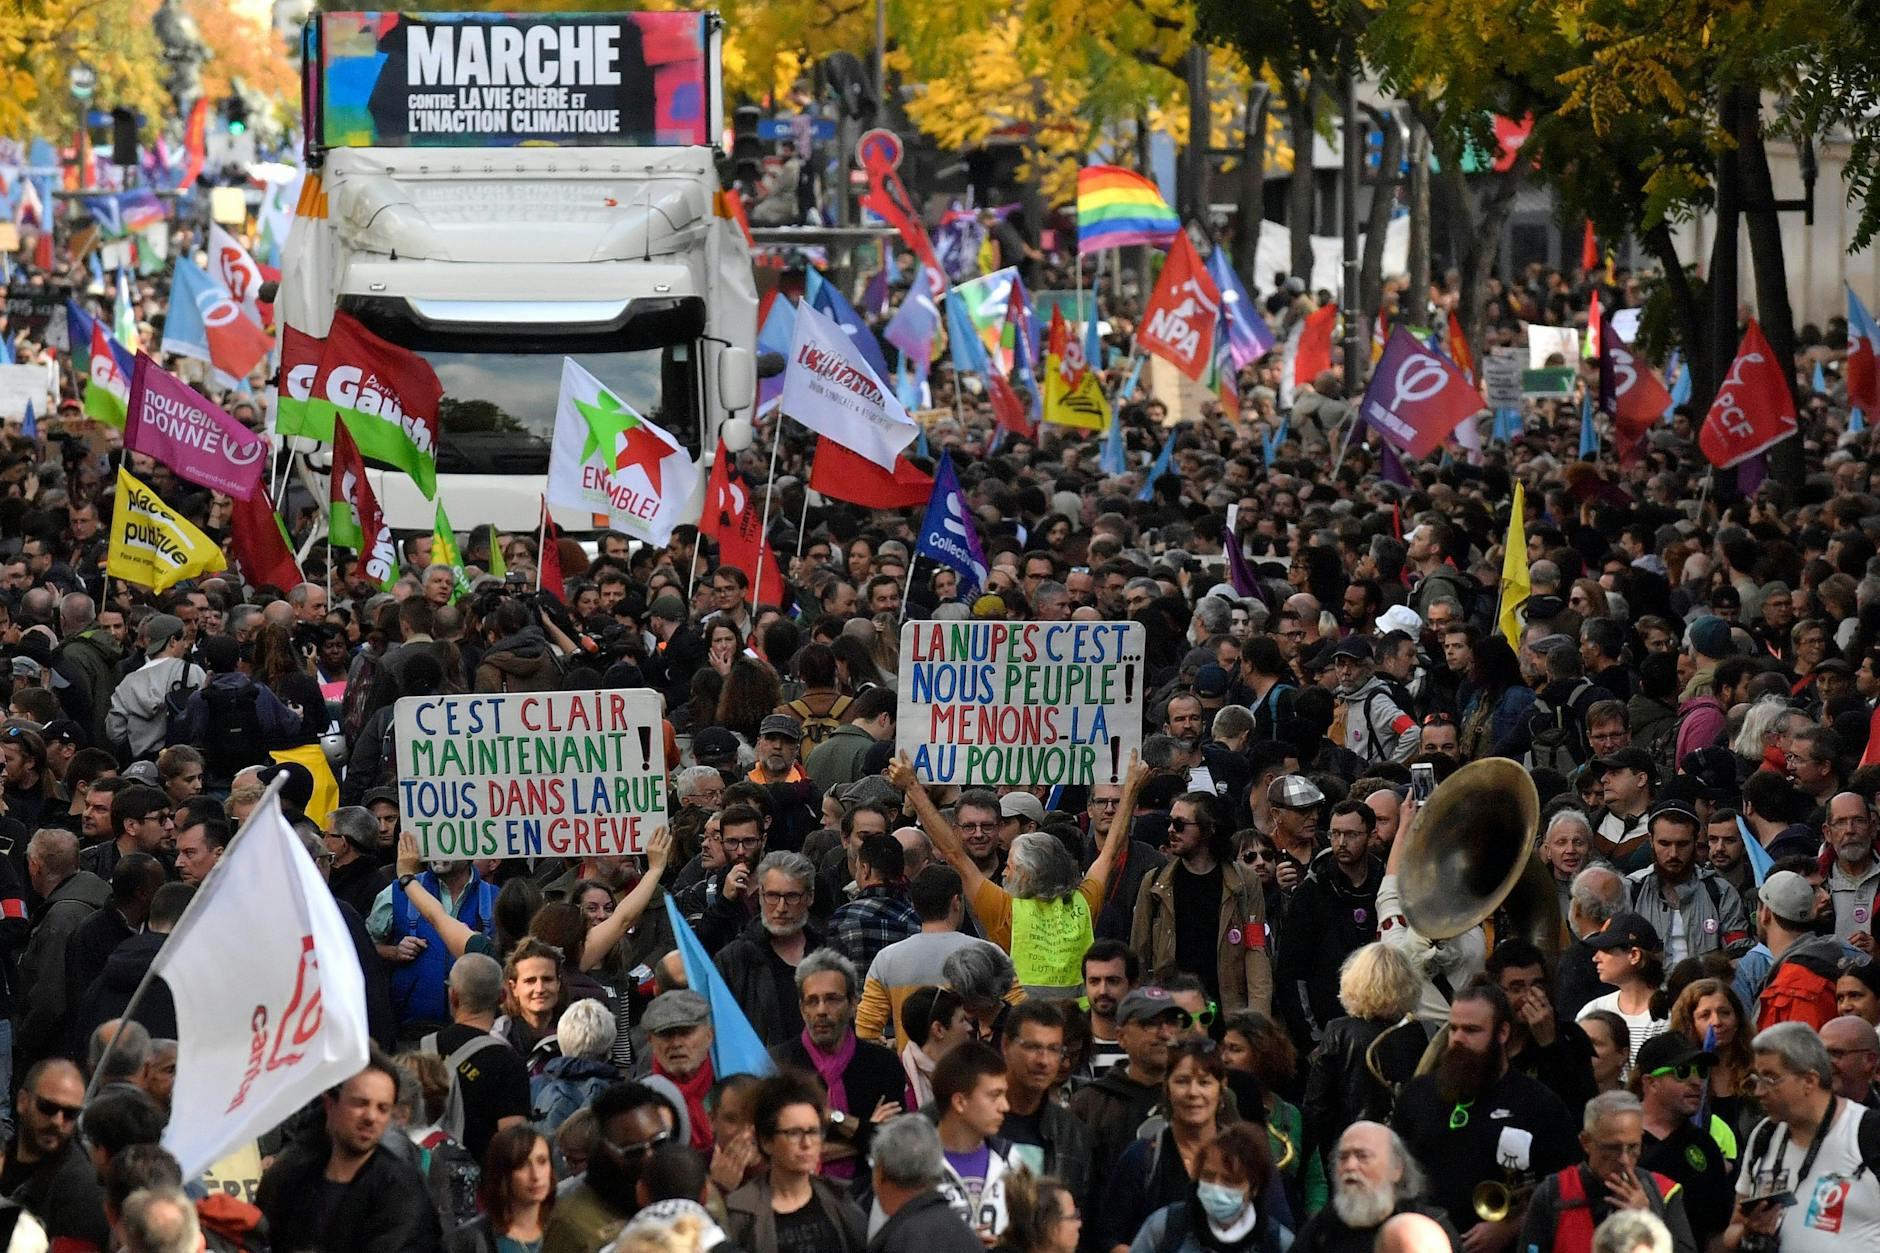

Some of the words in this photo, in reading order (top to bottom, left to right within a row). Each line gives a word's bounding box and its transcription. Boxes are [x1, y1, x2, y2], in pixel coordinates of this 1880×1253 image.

[407, 25, 621, 87] MARCHE
[408, 94, 456, 109] CONTRE
[459, 88, 481, 109] LA
[481, 88, 511, 109] VIE
[512, 84, 569, 109] CHÈRE
[571, 93, 587, 109] ET
[408, 110, 508, 132] L'INACTION
[511, 110, 620, 133] CLIMATIQUE
[1146, 308, 1200, 361] NPA
[143, 404, 220, 454] DONNE
[1712, 392, 1754, 438] PCF
[912, 663, 995, 704] NOUS
[416, 698, 505, 735] C'EST
[914, 744, 957, 783] AU
[400, 781, 478, 819] TOUS
[488, 779, 565, 817] DANS
[572, 777, 611, 815] LA
[614, 775, 665, 813] RUE
[415, 820, 497, 857] TOUS
[505, 819, 541, 856] EN
[548, 810, 642, 855] GRÈVE
